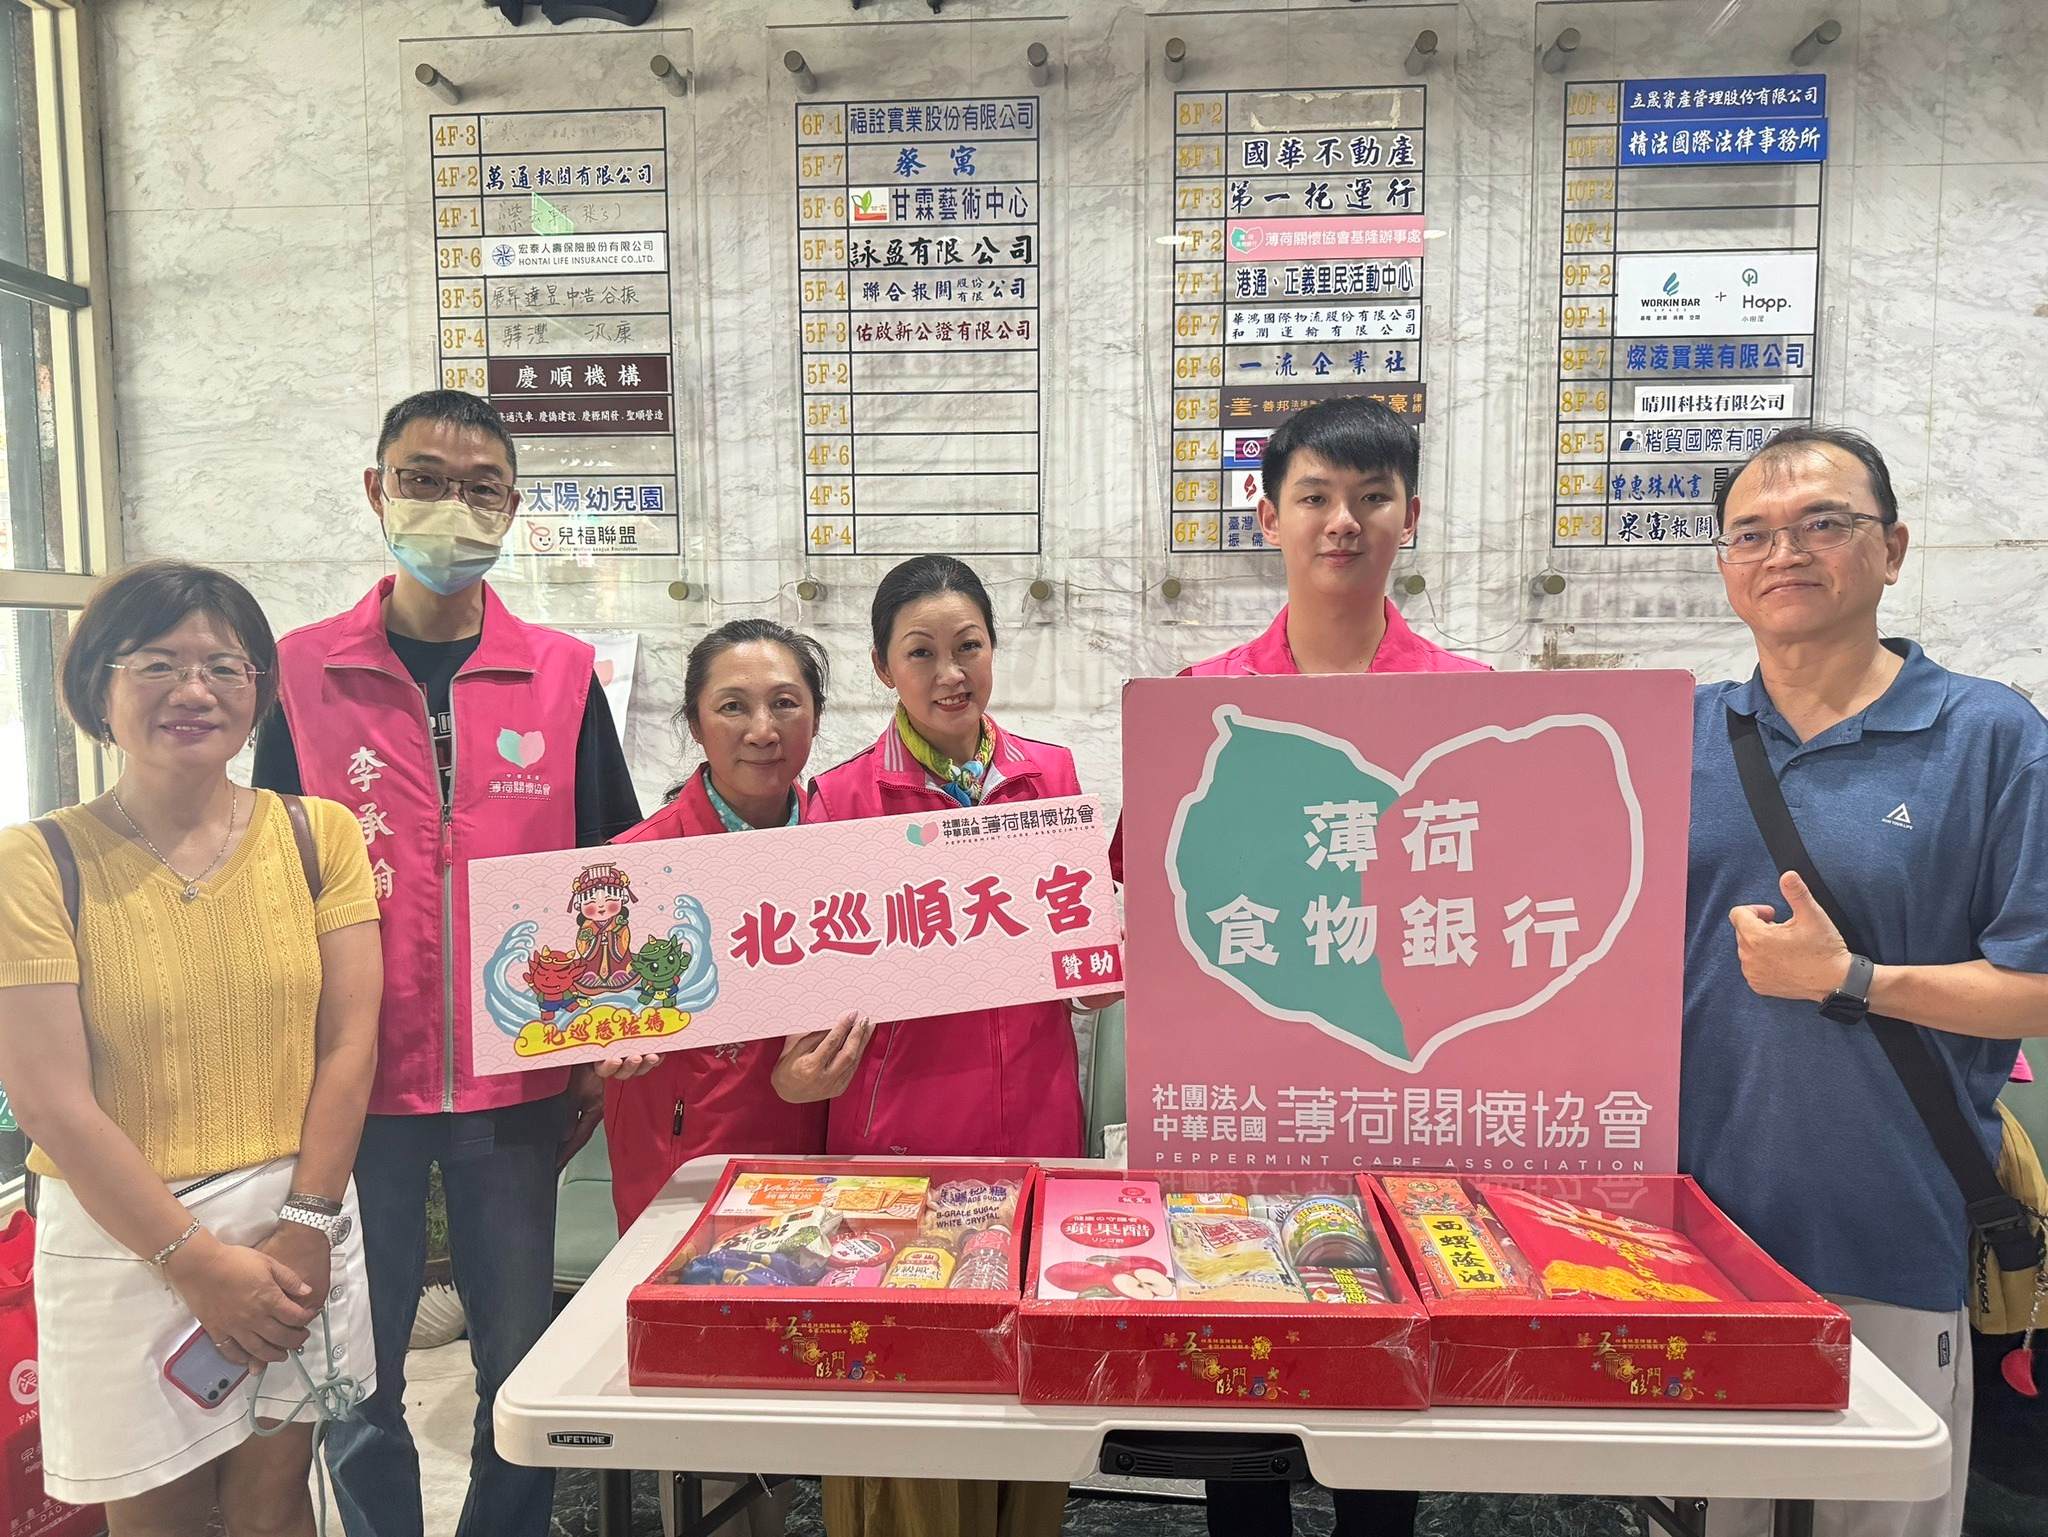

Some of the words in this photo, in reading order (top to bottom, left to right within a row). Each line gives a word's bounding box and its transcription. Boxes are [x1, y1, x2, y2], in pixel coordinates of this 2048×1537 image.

[1630, 86, 1818, 110] 立晟資產管理股份有限公司
[850, 102, 1034, 135] 福詮實業股份有限公司
[1244, 136, 1415, 168] 國華不動產
[1628, 126, 1821, 157] 精法國際法律事務所
[891, 186, 1029, 221] 甘霖藝術中心
[518, 240, 654, 254] 宏泰人壽保險股份有限公司
[850, 234, 1033, 268] 詠盈有限公司
[1265, 230, 1422, 247] 薄荷關懷協會基隆辦事處
[519, 258, 551, 266] HONTAI
[553, 257, 569, 265] LIFE
[571, 256, 618, 264] INSURANCE
[988, 277, 1026, 299] 公司
[1641, 298, 1680, 307] WORKIN
[1681, 298, 1700, 307] BAR
[1239, 350, 1406, 376] 一流企業社
[1626, 343, 1805, 371] 燦凌實業有限公司
[515, 364, 642, 389] 慶順機構
[558, 526, 637, 545] 兒福聯盟
[943, 826, 981, 838] 中華民國
[981, 804, 1095, 836] 薄荷關懷協會
[945, 834, 1001, 846] PEPPERMINT
[1035, 824, 1096, 836] ASSOCIATION
[1303, 798, 1481, 873] 薄荷
[729, 864, 1096, 969] 北巡順天宮
[1206, 894, 1581, 968] 食物銀行
[1060, 951, 1115, 981] 贊助
[1152, 1083, 1267, 1112] 社團法人
[1277, 1085, 1653, 1149] 薄荷關懷協會
[1152, 1114, 1267, 1143] 中華民國
[1155, 1152, 1330, 1166] PEPPERMINT
[1353, 1156, 1421, 1167] CARE
[1445, 1158, 1645, 1172] ASSOCIATION
[936, 1218, 962, 1228] WHITE
[966, 1212, 1000, 1226] CRYSTAL
[1065, 1222, 1151, 1238] 蘋果醋
[556, 1434, 606, 1444] LIFETIME
